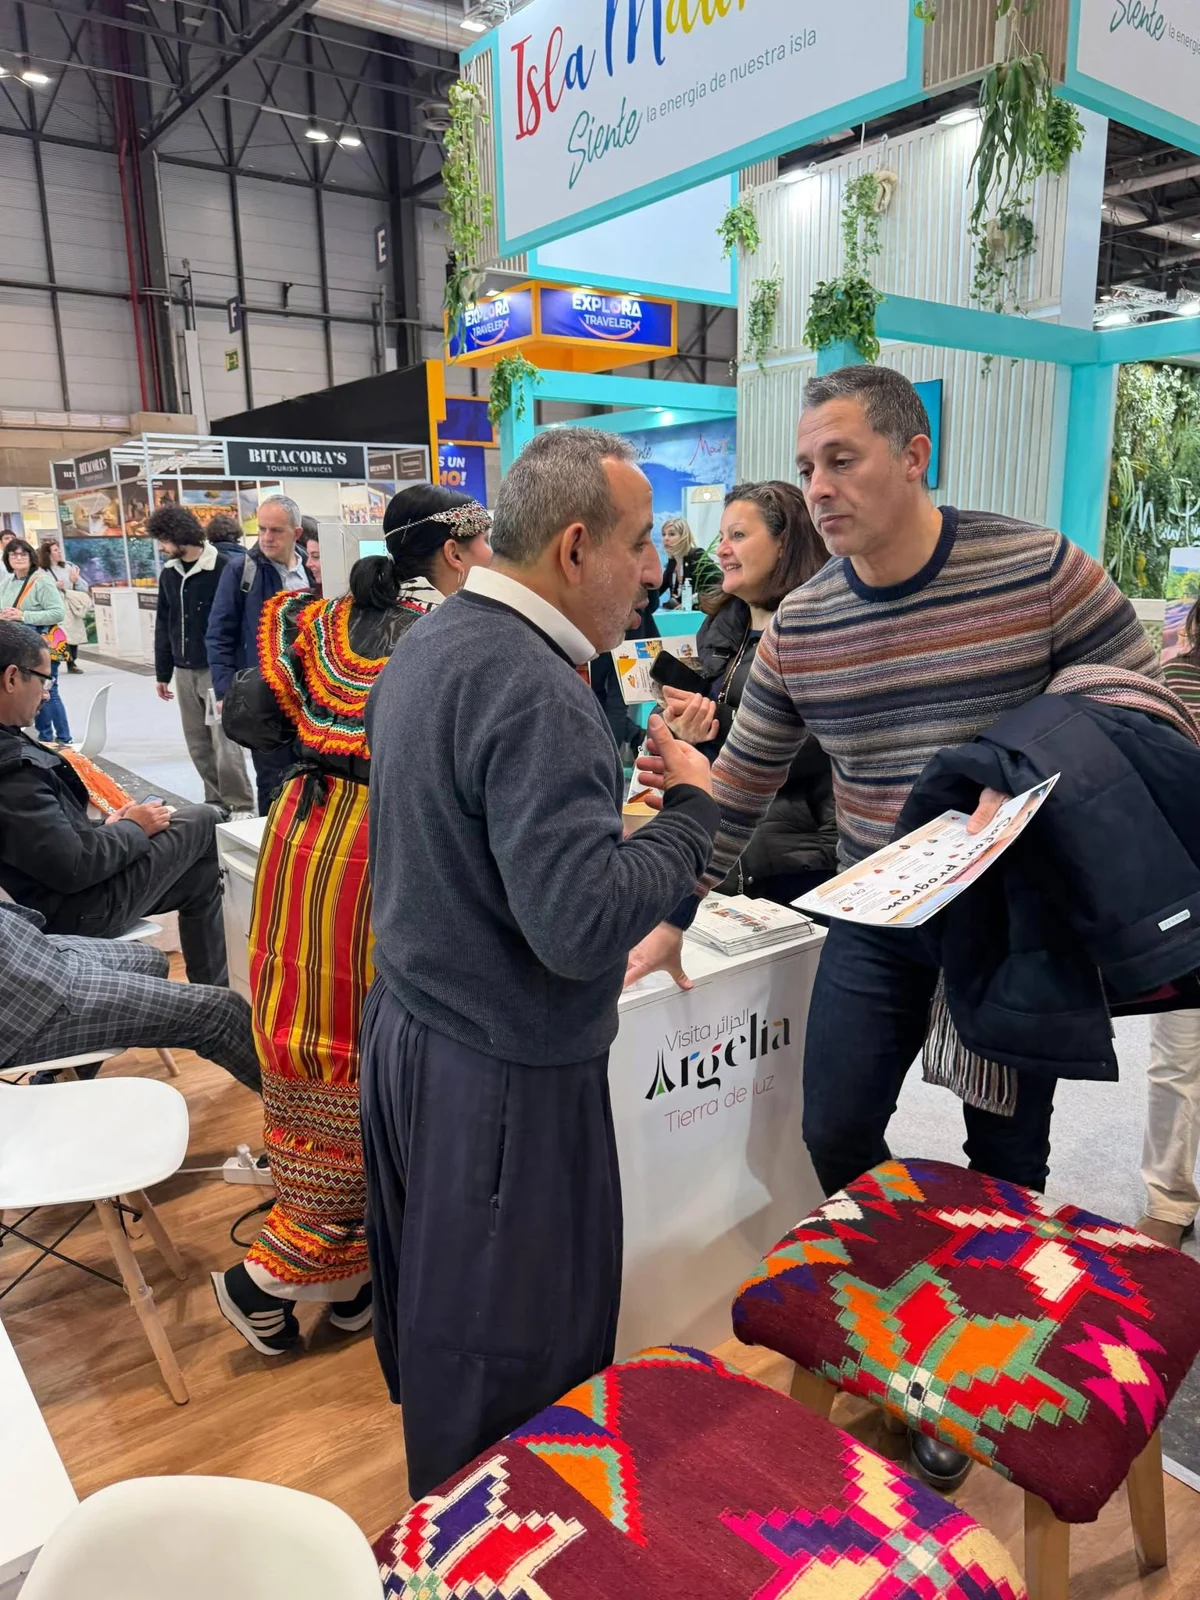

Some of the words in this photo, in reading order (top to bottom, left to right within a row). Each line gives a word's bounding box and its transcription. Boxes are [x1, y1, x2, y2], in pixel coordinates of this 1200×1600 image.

[1169, 22, 1175, 38] la
[510, 26, 596, 140] Isla
[567, 97, 643, 190] Siente
[647, 106, 657, 123] la
[710, 72, 726, 92] de
[730, 43, 786, 83] nuestra
[790, 27, 817, 55] isla
[377, 229, 387, 263] E
[229, 302, 237, 328] F
[464, 298, 511, 327] EXPLORA
[572, 292, 642, 318] EXPLORA
[472, 319, 504, 337] TRAVELER
[584, 313, 632, 330] TRAVELER
[248, 448, 347, 466] BITACORA'S
[266, 465, 299, 473] TOURISM
[301, 466, 333, 474] SERVICES
[447, 456, 466, 468] UN
[960, 816, 1012, 861] Safari
[881, 864, 959, 911] program
[665, 1023, 711, 1052] Visita
[645, 1012, 791, 1100] Argelia
[664, 1100, 719, 1132] Tierra
[723, 1086, 748, 1108] de
[752, 1075, 775, 1097] luz
